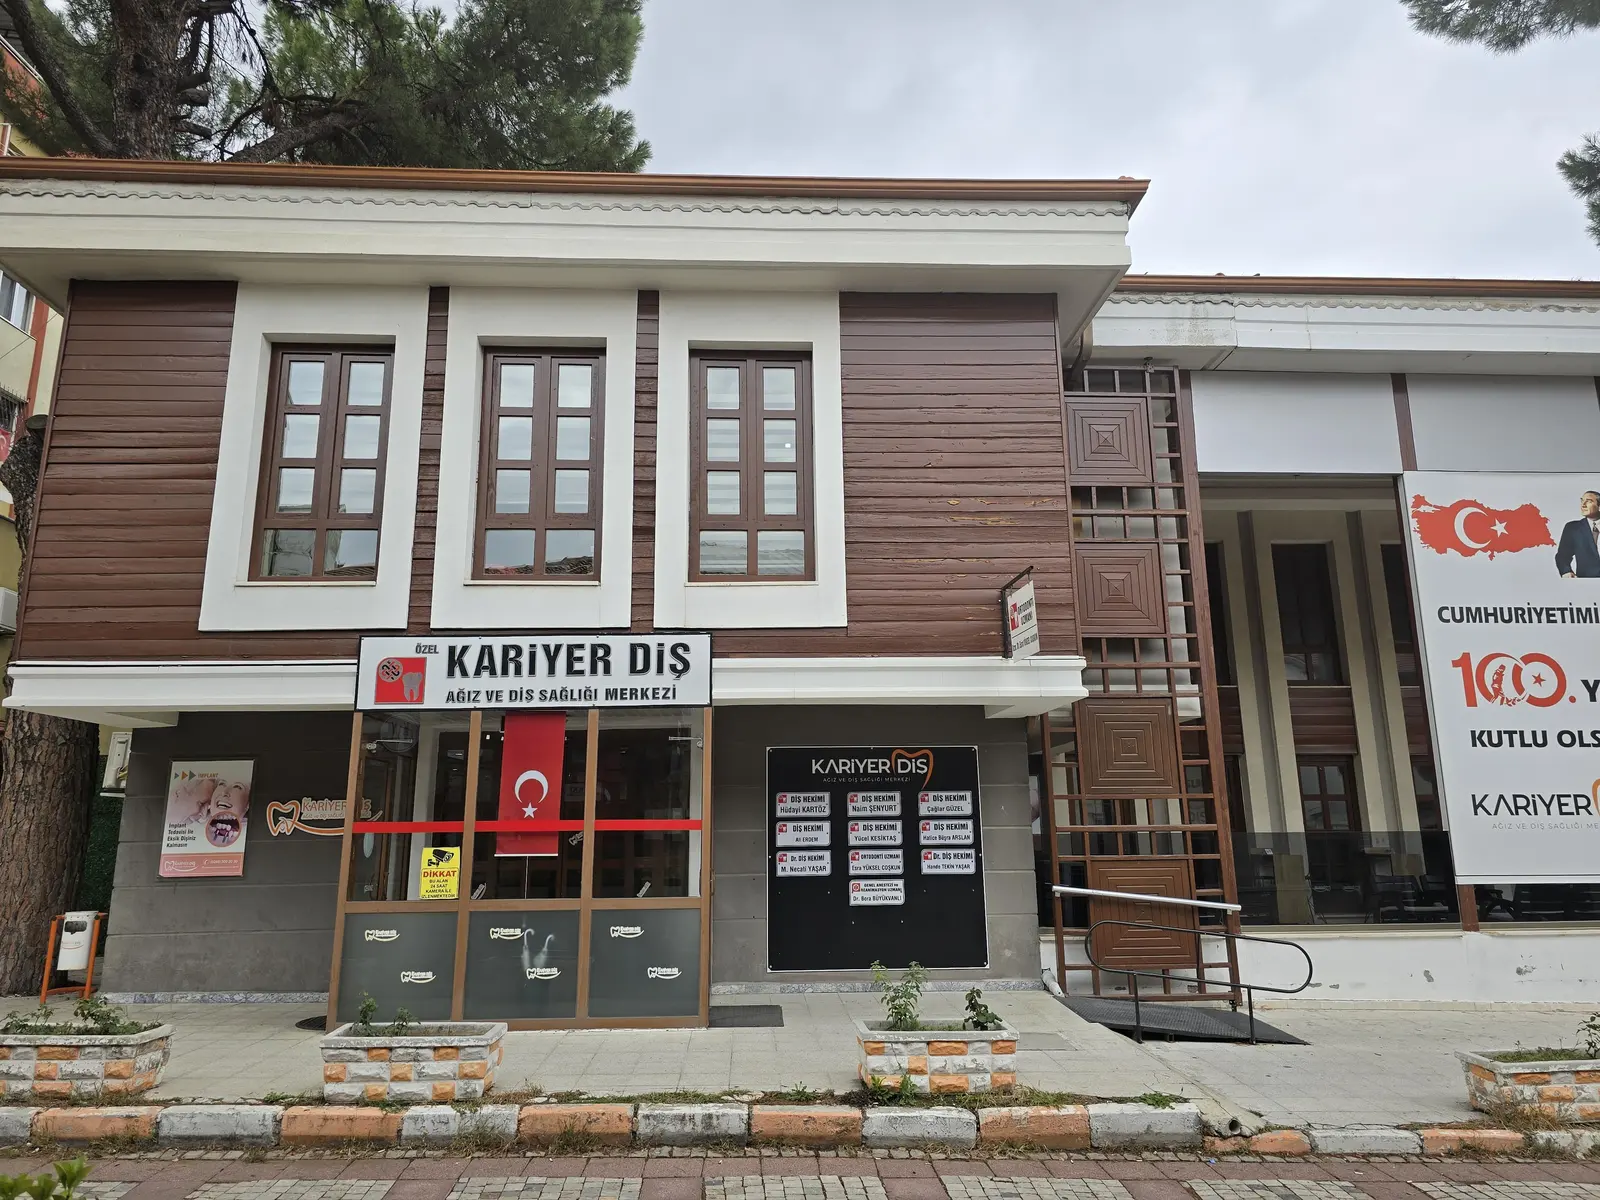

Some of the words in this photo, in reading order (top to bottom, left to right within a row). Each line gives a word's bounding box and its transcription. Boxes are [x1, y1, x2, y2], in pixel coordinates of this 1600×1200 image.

[1438, 602, 1600, 624] CUMHURİYETİMİ
[415, 643, 440, 654] ÖZEL
[446, 642, 612, 678] KARİYER
[629, 642, 692, 680] DİŞ
[445, 688, 482, 704] AĞIZ
[486, 690, 504, 702] VE
[508, 686, 536, 703] DİŞ
[539, 686, 598, 702] SAĞLIĞI
[605, 684, 677, 701] MERKEZİ
[1470, 730, 1548, 748] KUTLU
[811, 758, 891, 774] KARİYER
[897, 758, 928, 774] DİŞ
[790, 795, 802, 803] DİŞ
[803, 794, 826, 802] HEKİMİ
[862, 794, 872, 802] DİŞ
[874, 794, 896, 802] HEKİMİ
[933, 794, 944, 802] DİŞ
[780, 806, 800, 814] Hüdayi
[869, 804, 897, 813] ŞENYURT
[1471, 794, 1594, 816] KARİYER
[792, 824, 802, 832] DİŞ
[863, 823, 874, 832] DİŞ
